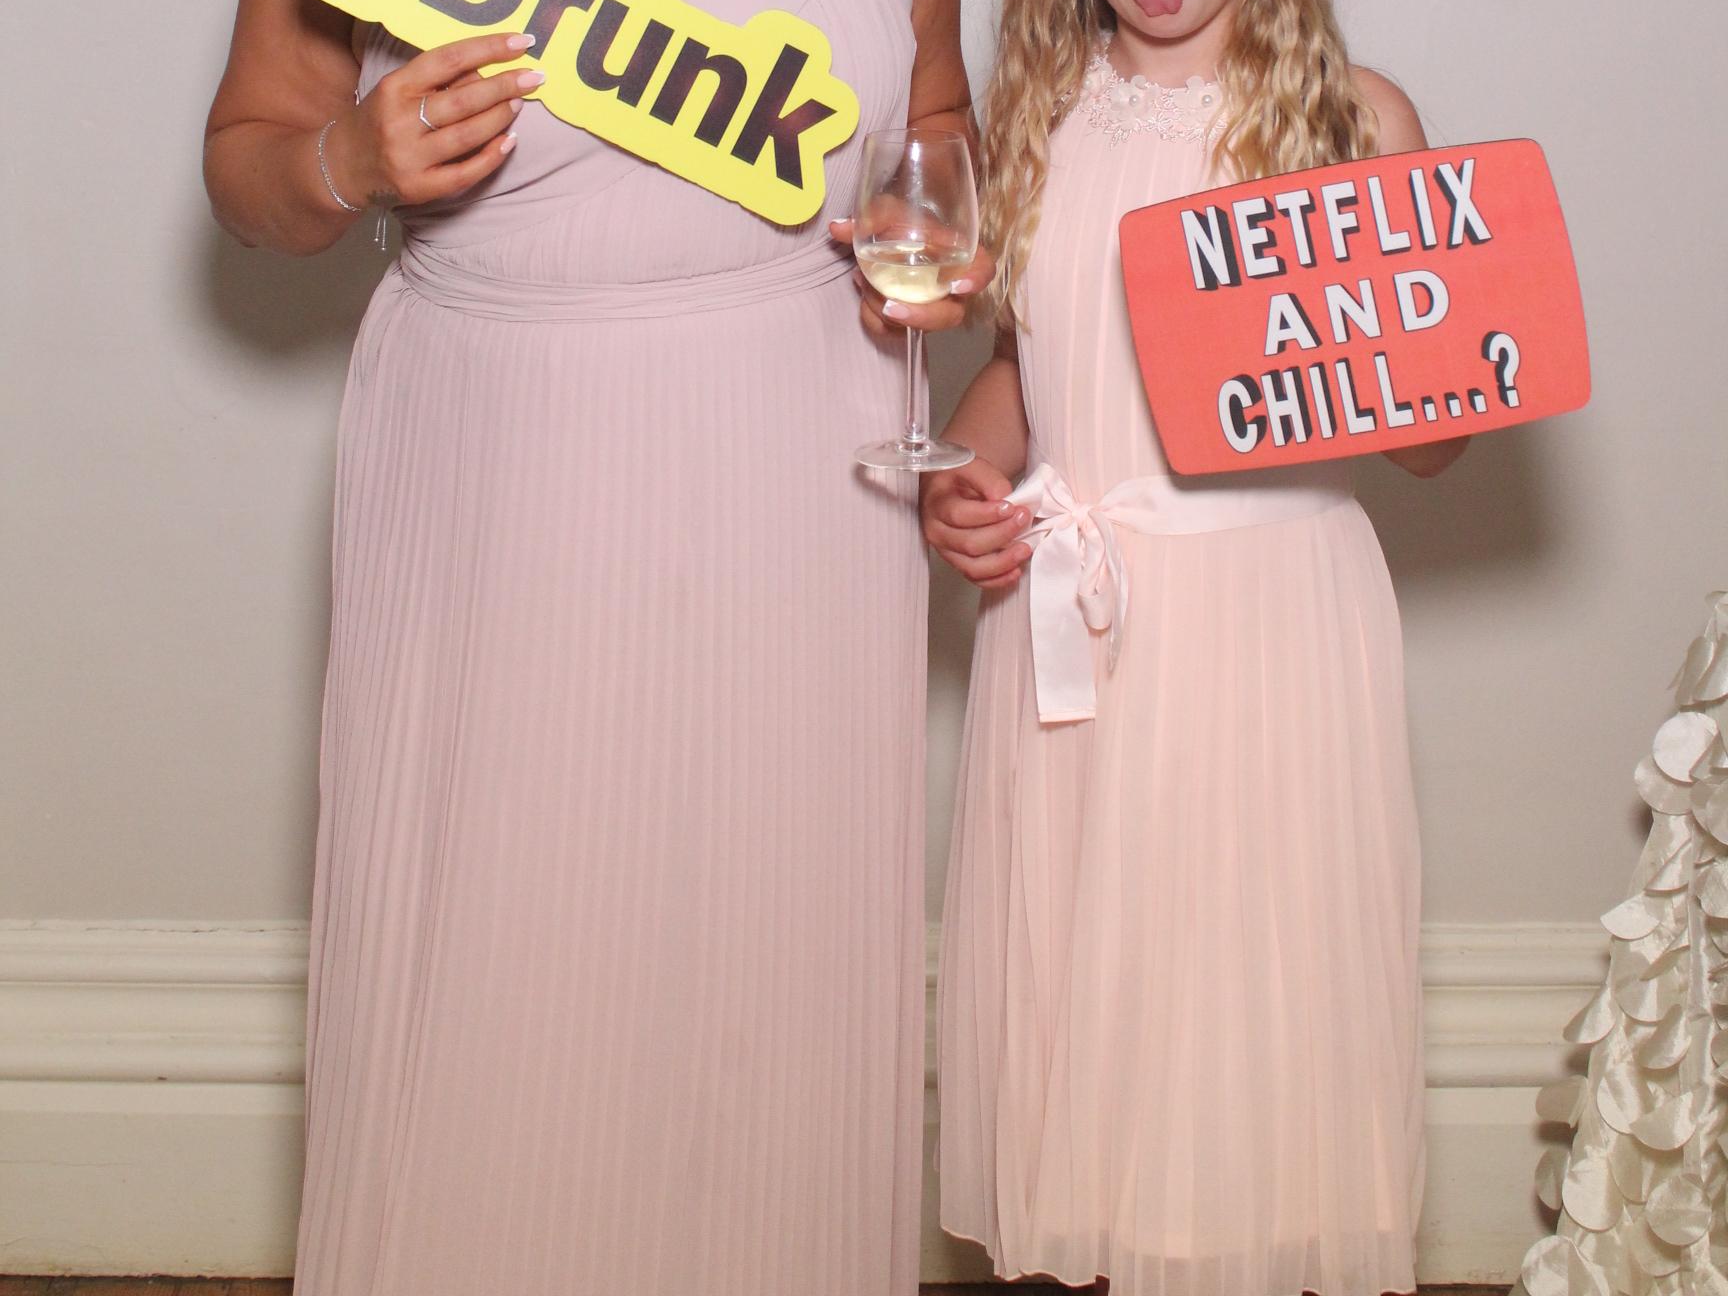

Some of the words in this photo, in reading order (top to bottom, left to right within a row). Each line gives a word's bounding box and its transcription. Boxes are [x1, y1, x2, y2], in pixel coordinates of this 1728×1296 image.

[1180, 158, 1492, 290] NETFLIX
[1264, 270, 1450, 356] AND
[1217, 331, 1521, 454] CHILL...?
